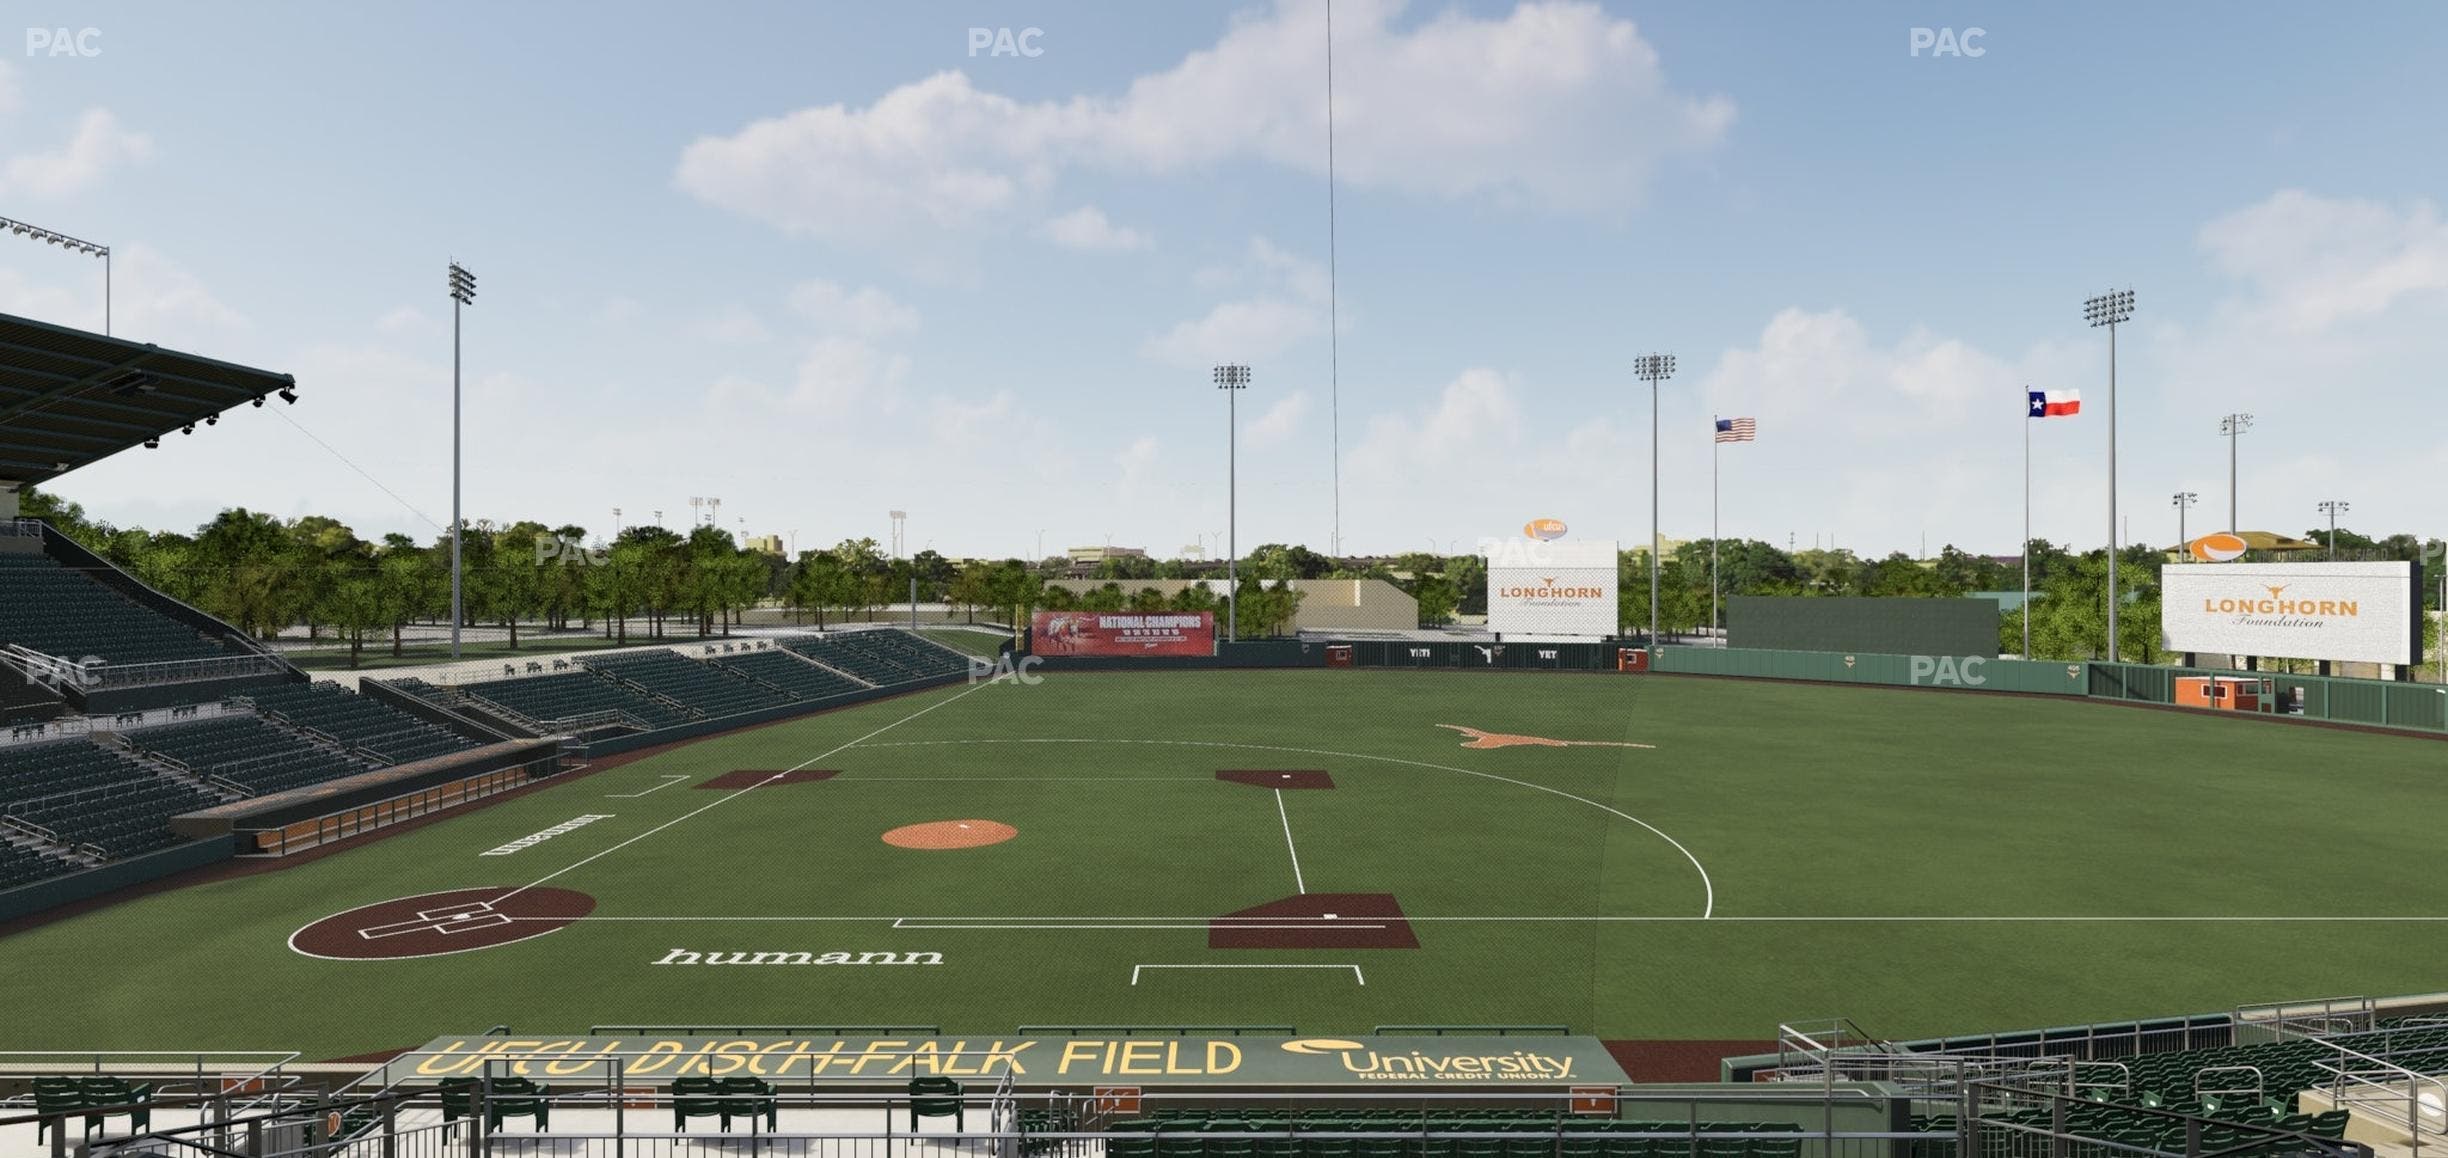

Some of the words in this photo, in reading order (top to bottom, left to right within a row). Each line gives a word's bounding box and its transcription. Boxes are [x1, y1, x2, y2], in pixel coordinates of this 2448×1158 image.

[1500, 587, 1602, 598] LONGHORN
[2205, 598, 2358, 616] LONGHORN
[1099, 615, 1144, 629] NATIONAL
[1145, 615, 1202, 629] CHAMPIONS
[2231, 613, 2324, 629] Foundation
[650, 948, 944, 965] humann
[416, 1040, 621, 1075] UFCU
[624, 1040, 1037, 1075] DISCH-FALK
[1057, 1040, 1242, 1074] FIELD
[1341, 1051, 1573, 1078] University
